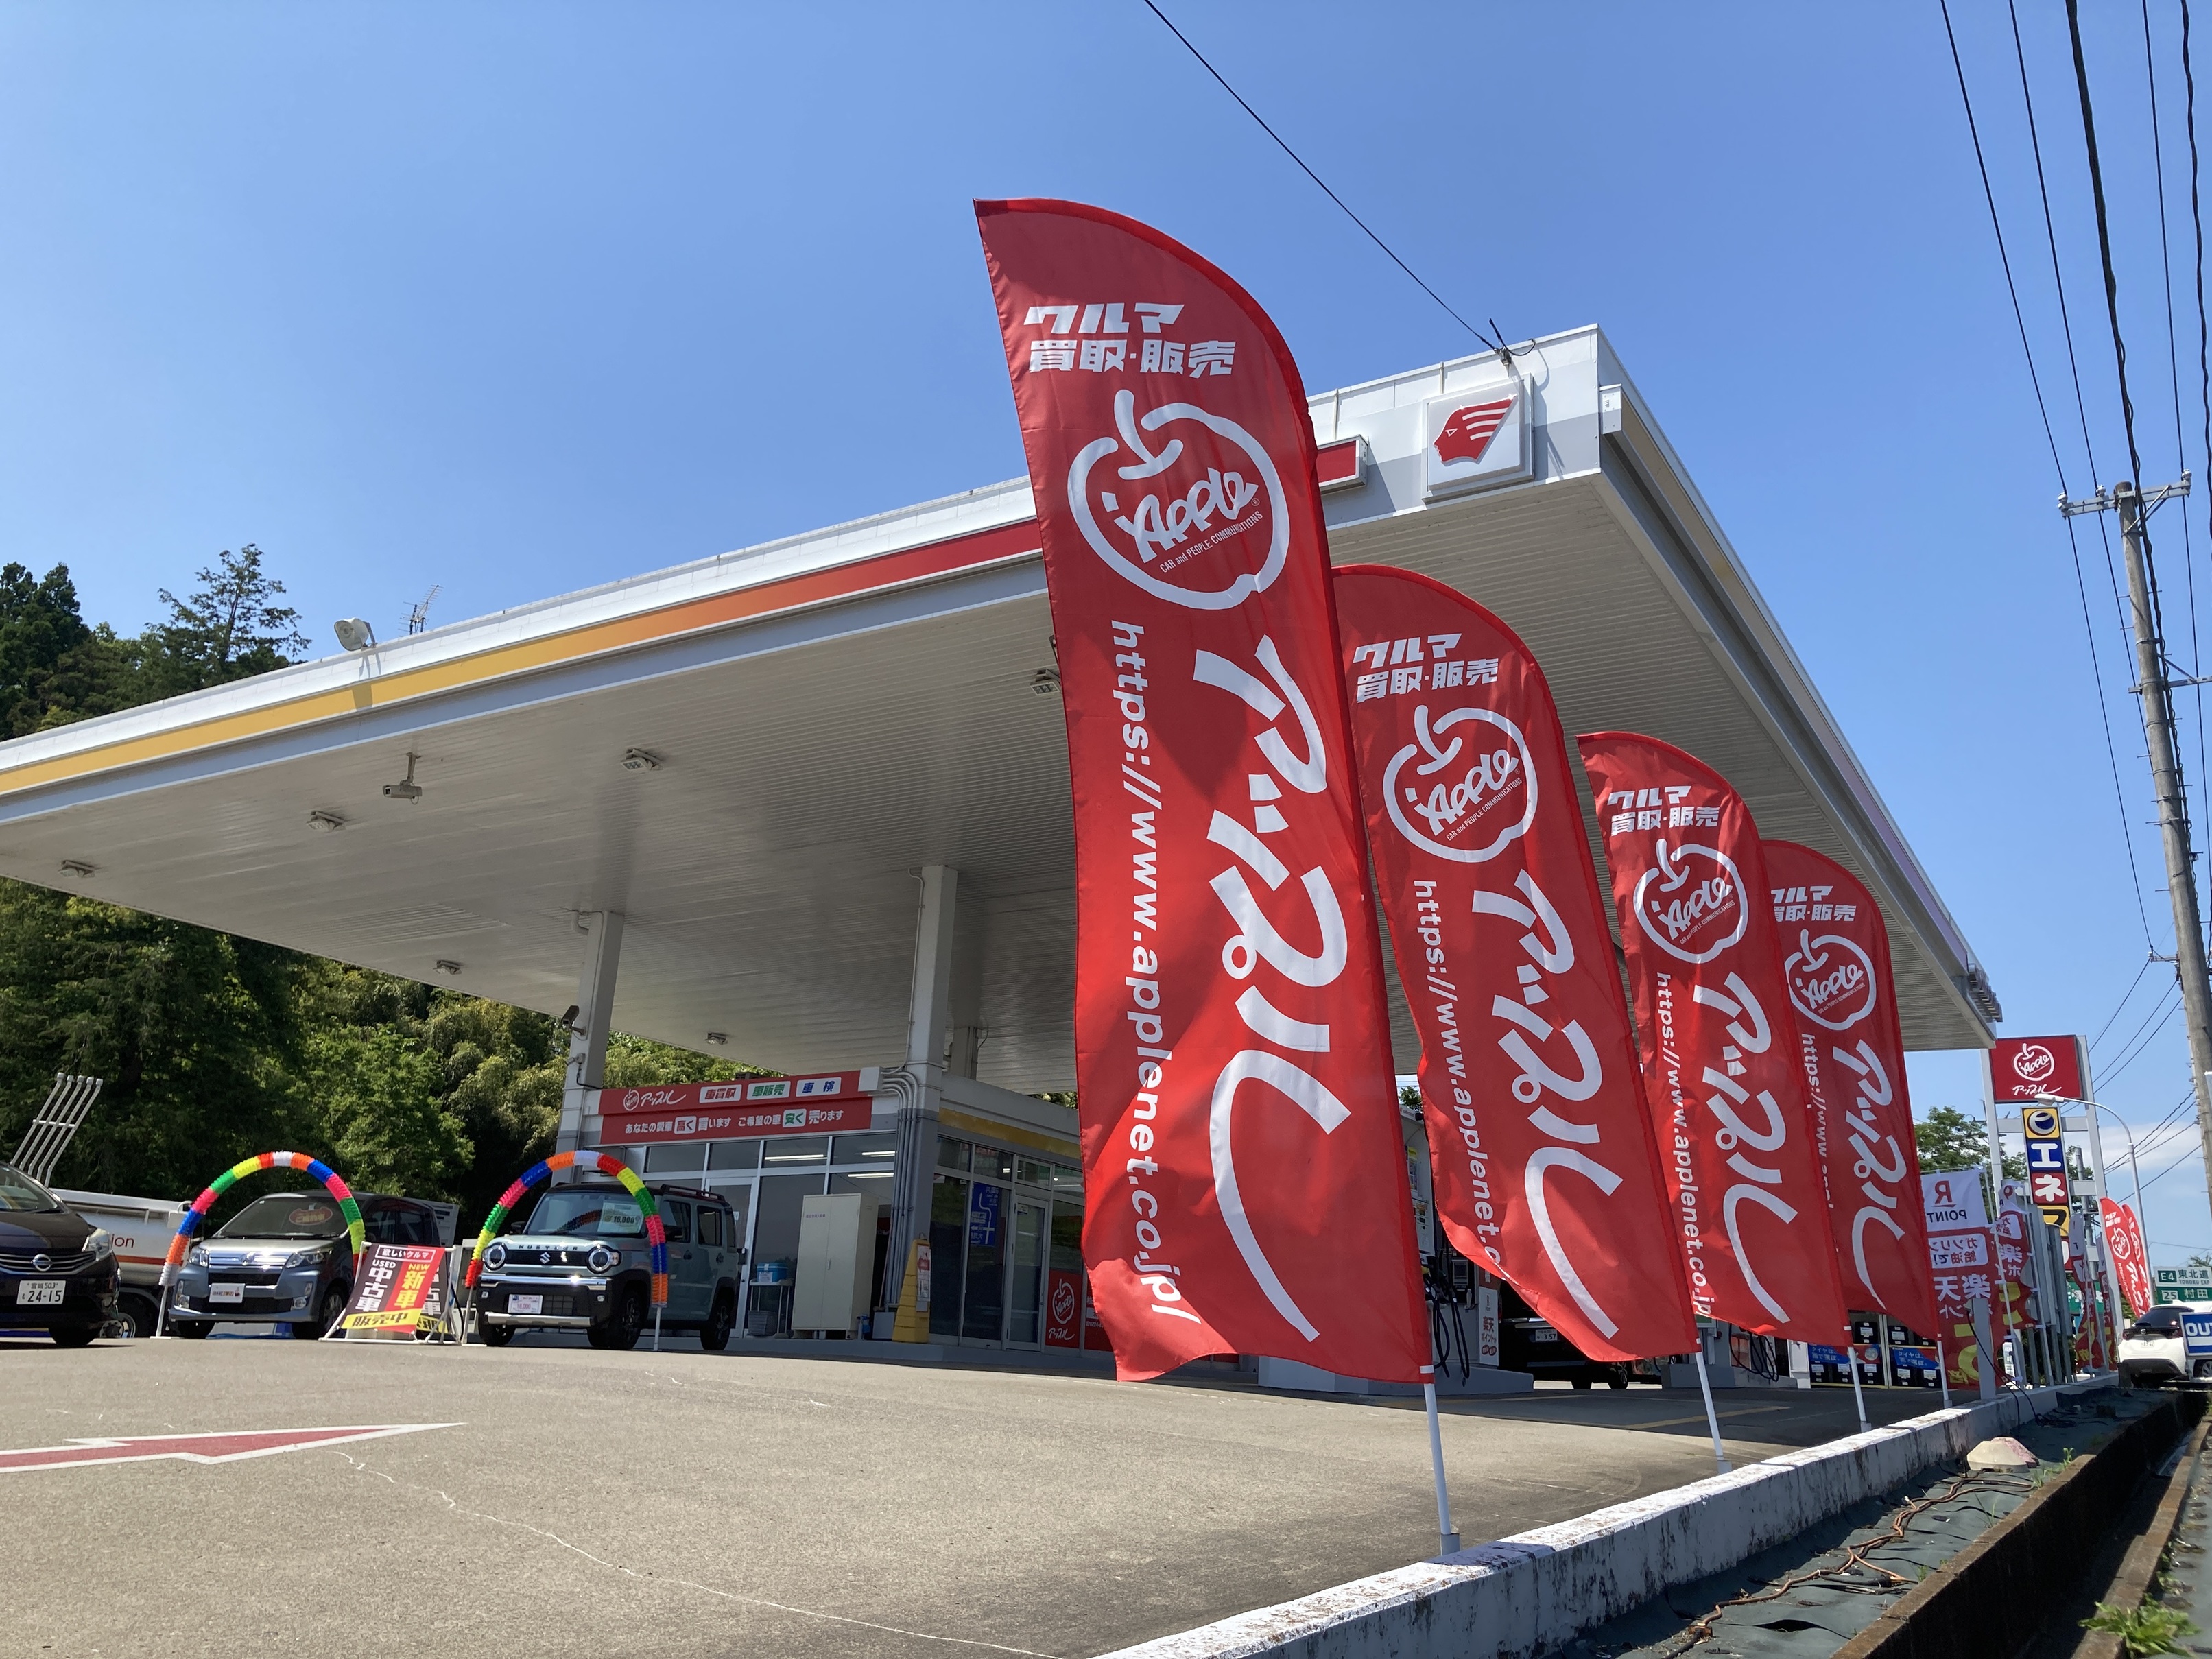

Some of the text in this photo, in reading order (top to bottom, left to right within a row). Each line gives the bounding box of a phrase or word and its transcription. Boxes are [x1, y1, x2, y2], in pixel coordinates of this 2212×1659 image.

[1023, 303, 1185, 334] クルマ
[1029, 339, 1236, 379] 買取・販売
[1159, 559, 1176, 573] CAR
[1175, 553, 1189, 565] and
[1186, 540, 1213, 558] PEOPLE
[1353, 633, 1462, 669] クルマ
[1357, 658, 1499, 704] 買取・販売
[1446, 776, 1523, 841] CAR and PEOPLE COMMUNICATIONS
[1607, 785, 1692, 810] クルマ
[1193, 634, 1353, 1342] アップル
[705, 1088, 737, 1100] 車買取
[752, 1084, 785, 1097] 車販売
[1472, 868, 1624, 1339] アップル
[1693, 971, 1798, 1324] アップル
[1832, 1038, 1907, 1310] アップル
[372, 1260, 396, 1269] USED
[382, 1248, 429, 1259] 欲しいクルマ
[2160, 1272, 2175, 1281] E4
[2178, 1269, 2209, 1279] 東北道
[27, 1290, 62, 1302] 24-15
[355, 1267, 393, 1312] 中古車
[394, 1270, 427, 1309] 新車
[2163, 1291, 2177, 1300] 25
[2184, 1289, 2208, 1298] 村田
[352, 1313, 409, 1327] 販売中
[1483, 1316, 1494, 1332] 楽天
